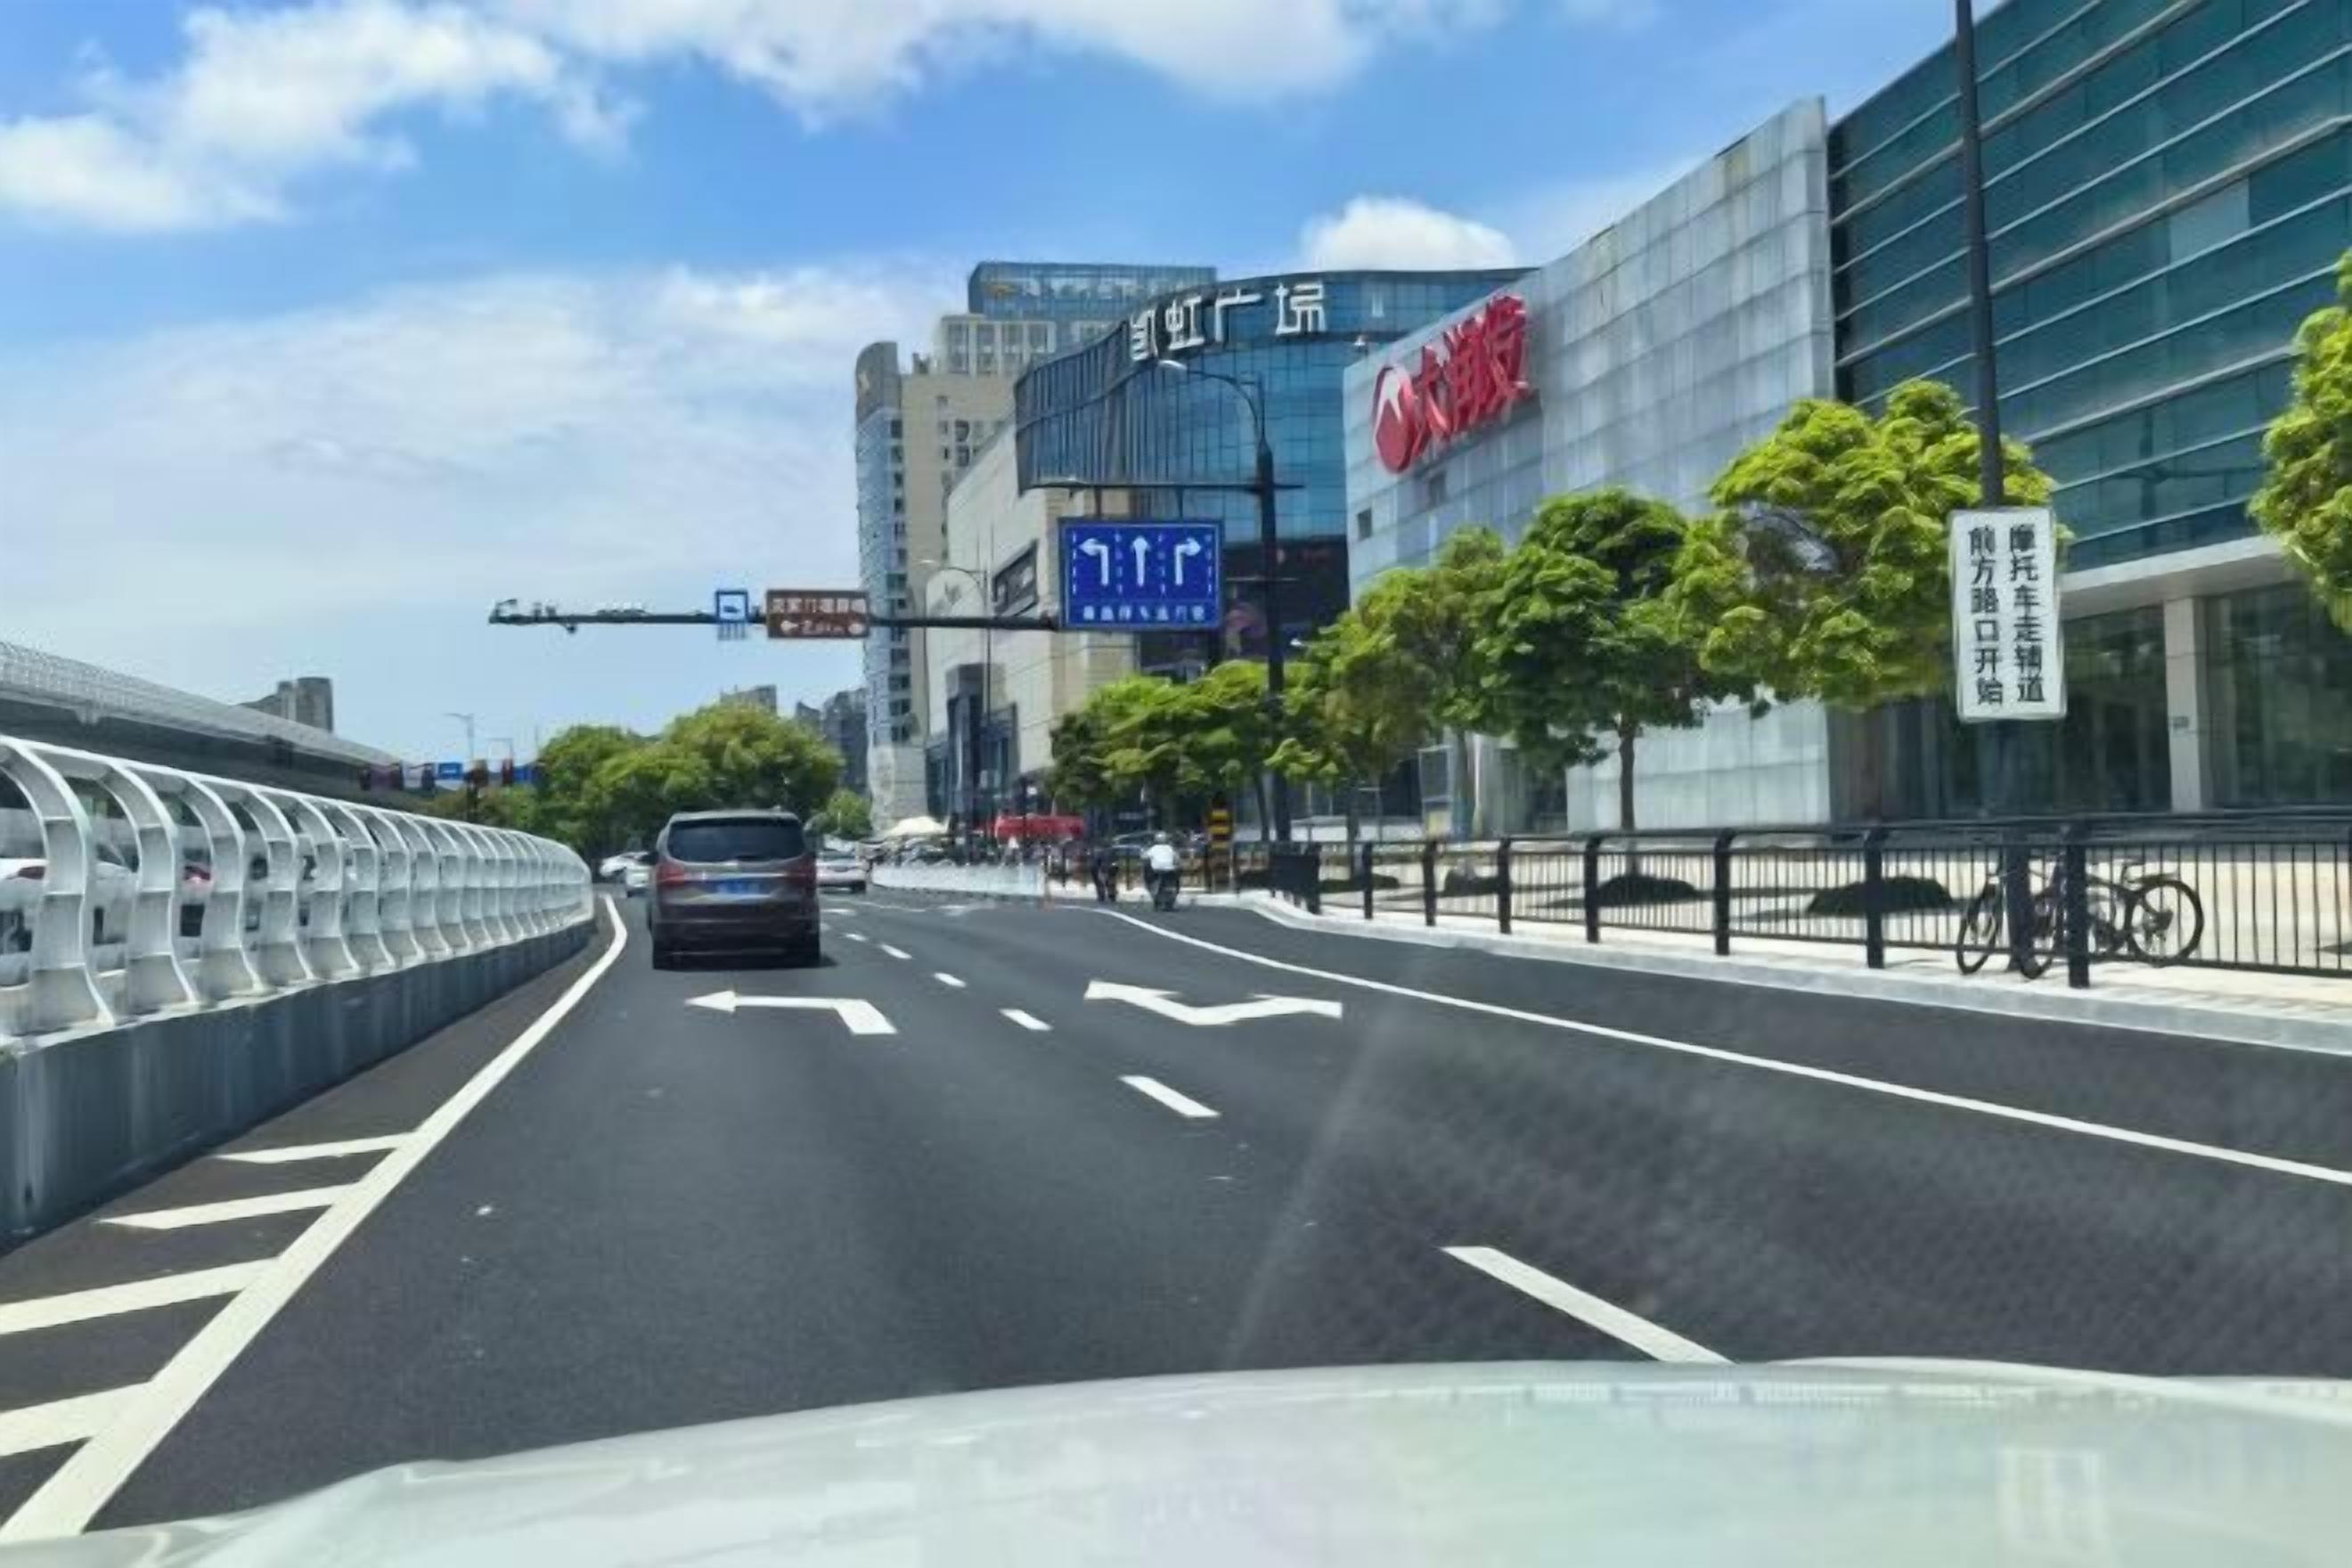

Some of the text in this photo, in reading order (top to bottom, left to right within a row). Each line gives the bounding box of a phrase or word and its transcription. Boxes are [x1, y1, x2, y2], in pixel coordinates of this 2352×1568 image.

[1130, 281, 1327, 362] 凯虹广场
[1968, 523, 2003, 706] 前方路口开始
[2008, 523, 2046, 703] 摩托车走辅道
